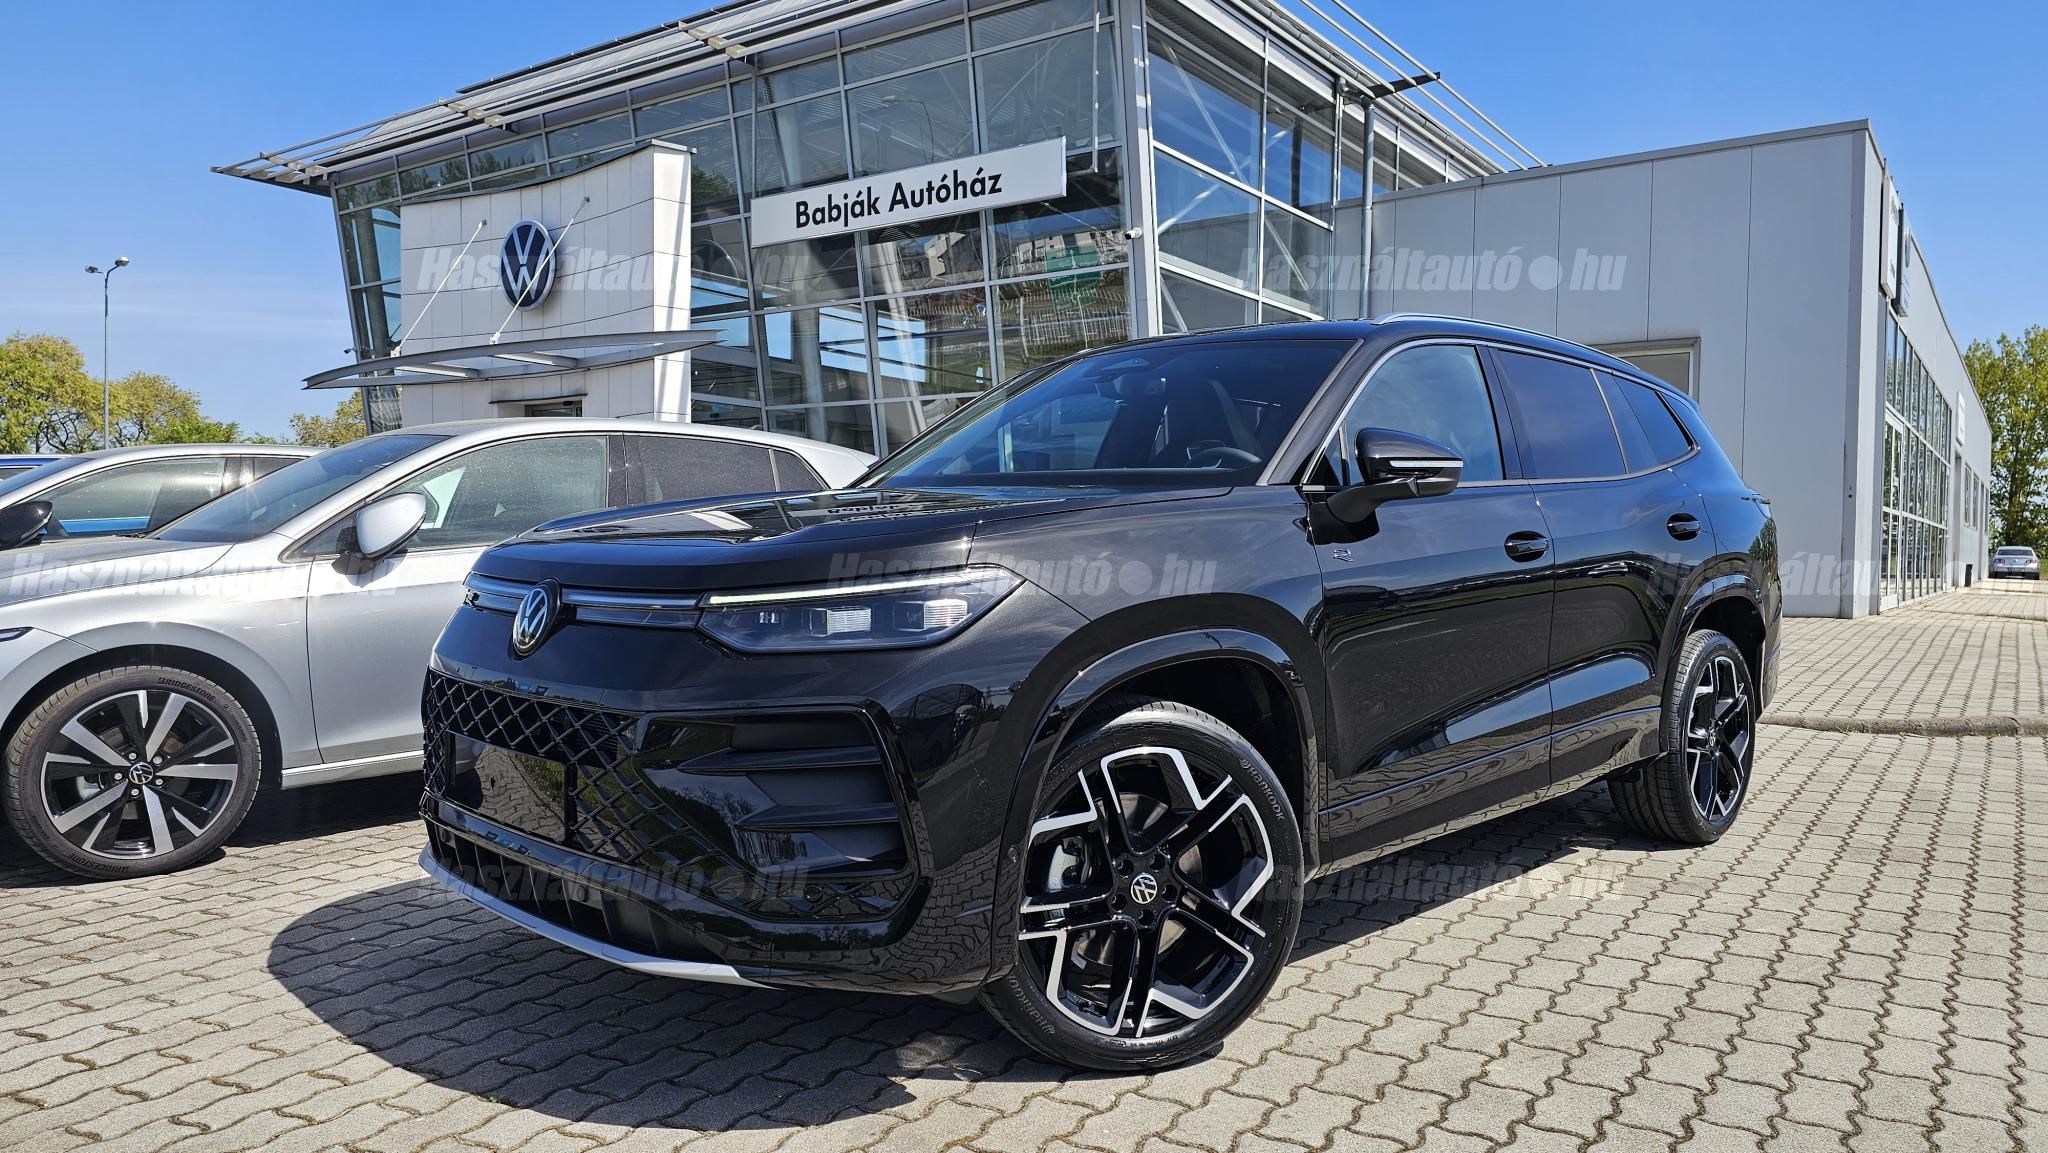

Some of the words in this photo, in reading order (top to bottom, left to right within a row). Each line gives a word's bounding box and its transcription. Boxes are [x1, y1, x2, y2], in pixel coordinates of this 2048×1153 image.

[796, 186, 880, 228] Babják
[888, 167, 1002, 212] Autóház
[158, 676, 217, 703] BRIDGESTONE
